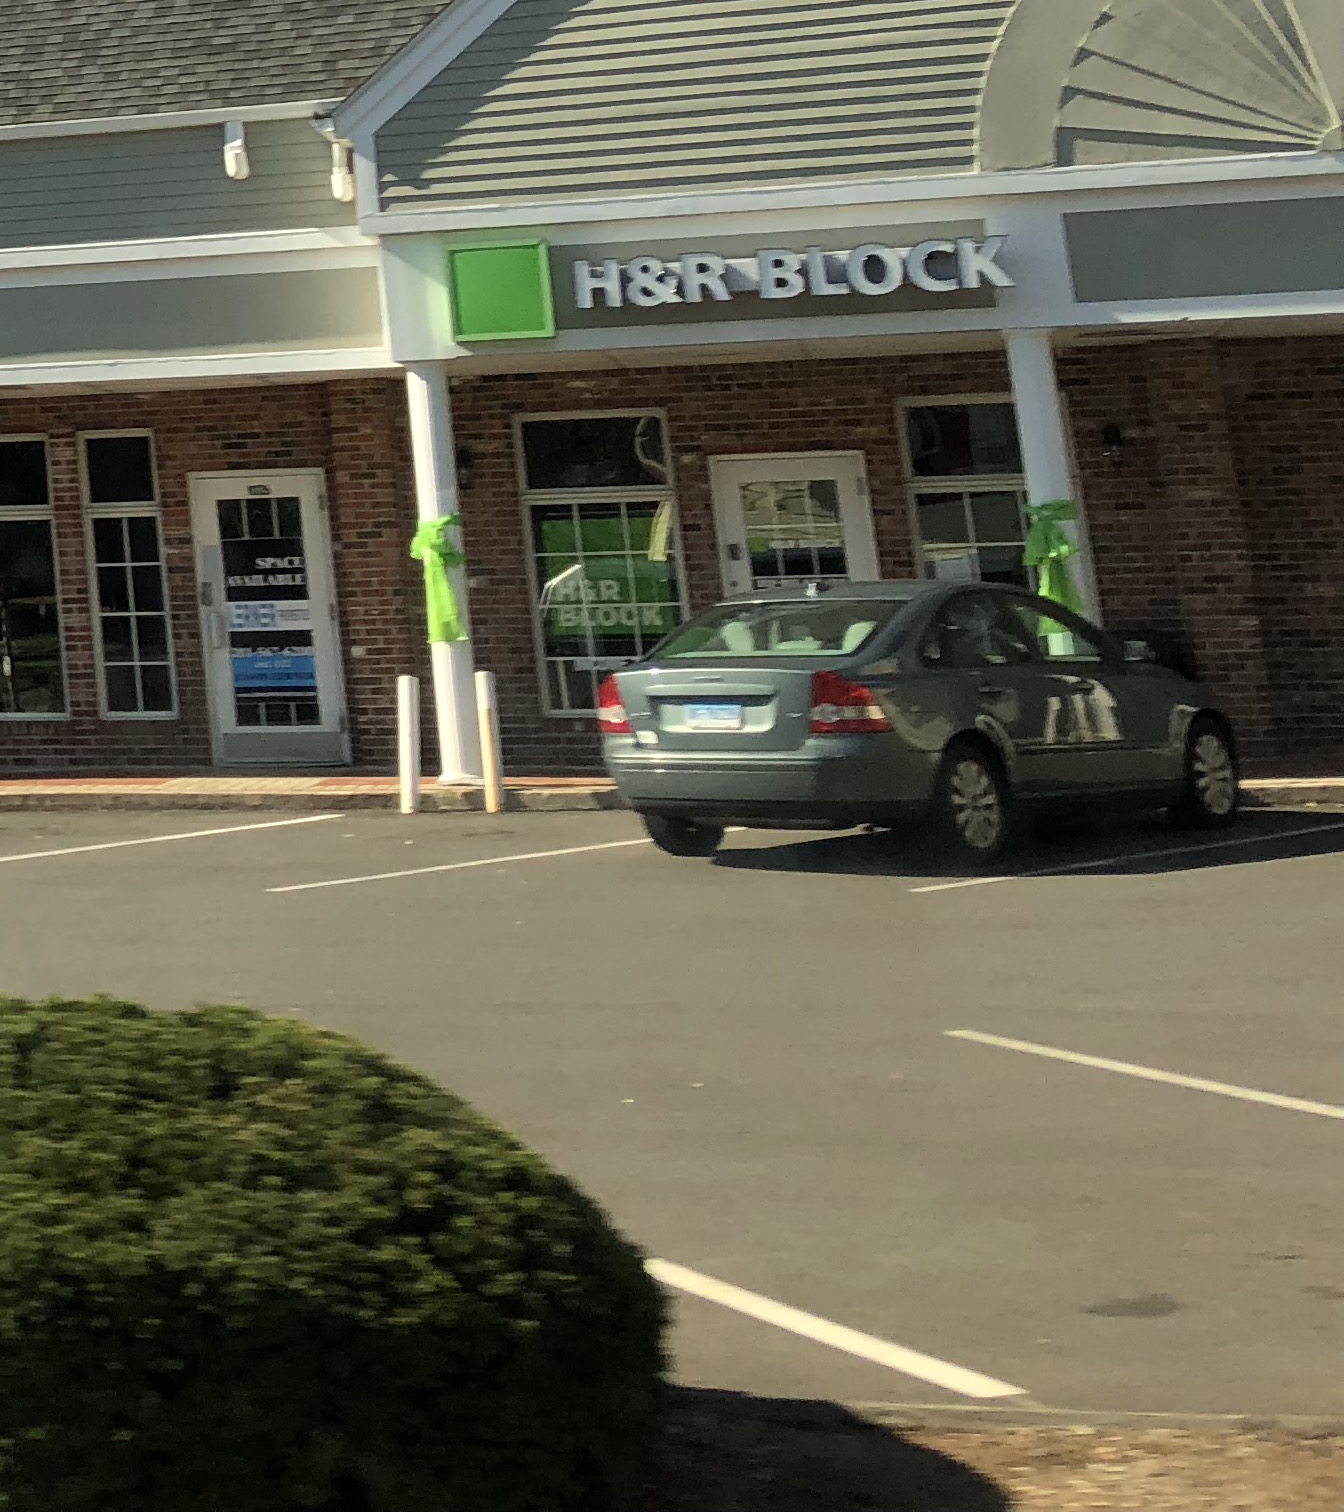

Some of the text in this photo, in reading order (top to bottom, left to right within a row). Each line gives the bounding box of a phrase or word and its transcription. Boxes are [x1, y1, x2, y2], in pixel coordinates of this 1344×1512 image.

[572, 234, 1017, 310] H&R BLOCK
[554, 578, 622, 601] H&R
[558, 605, 665, 627] BLOCK
